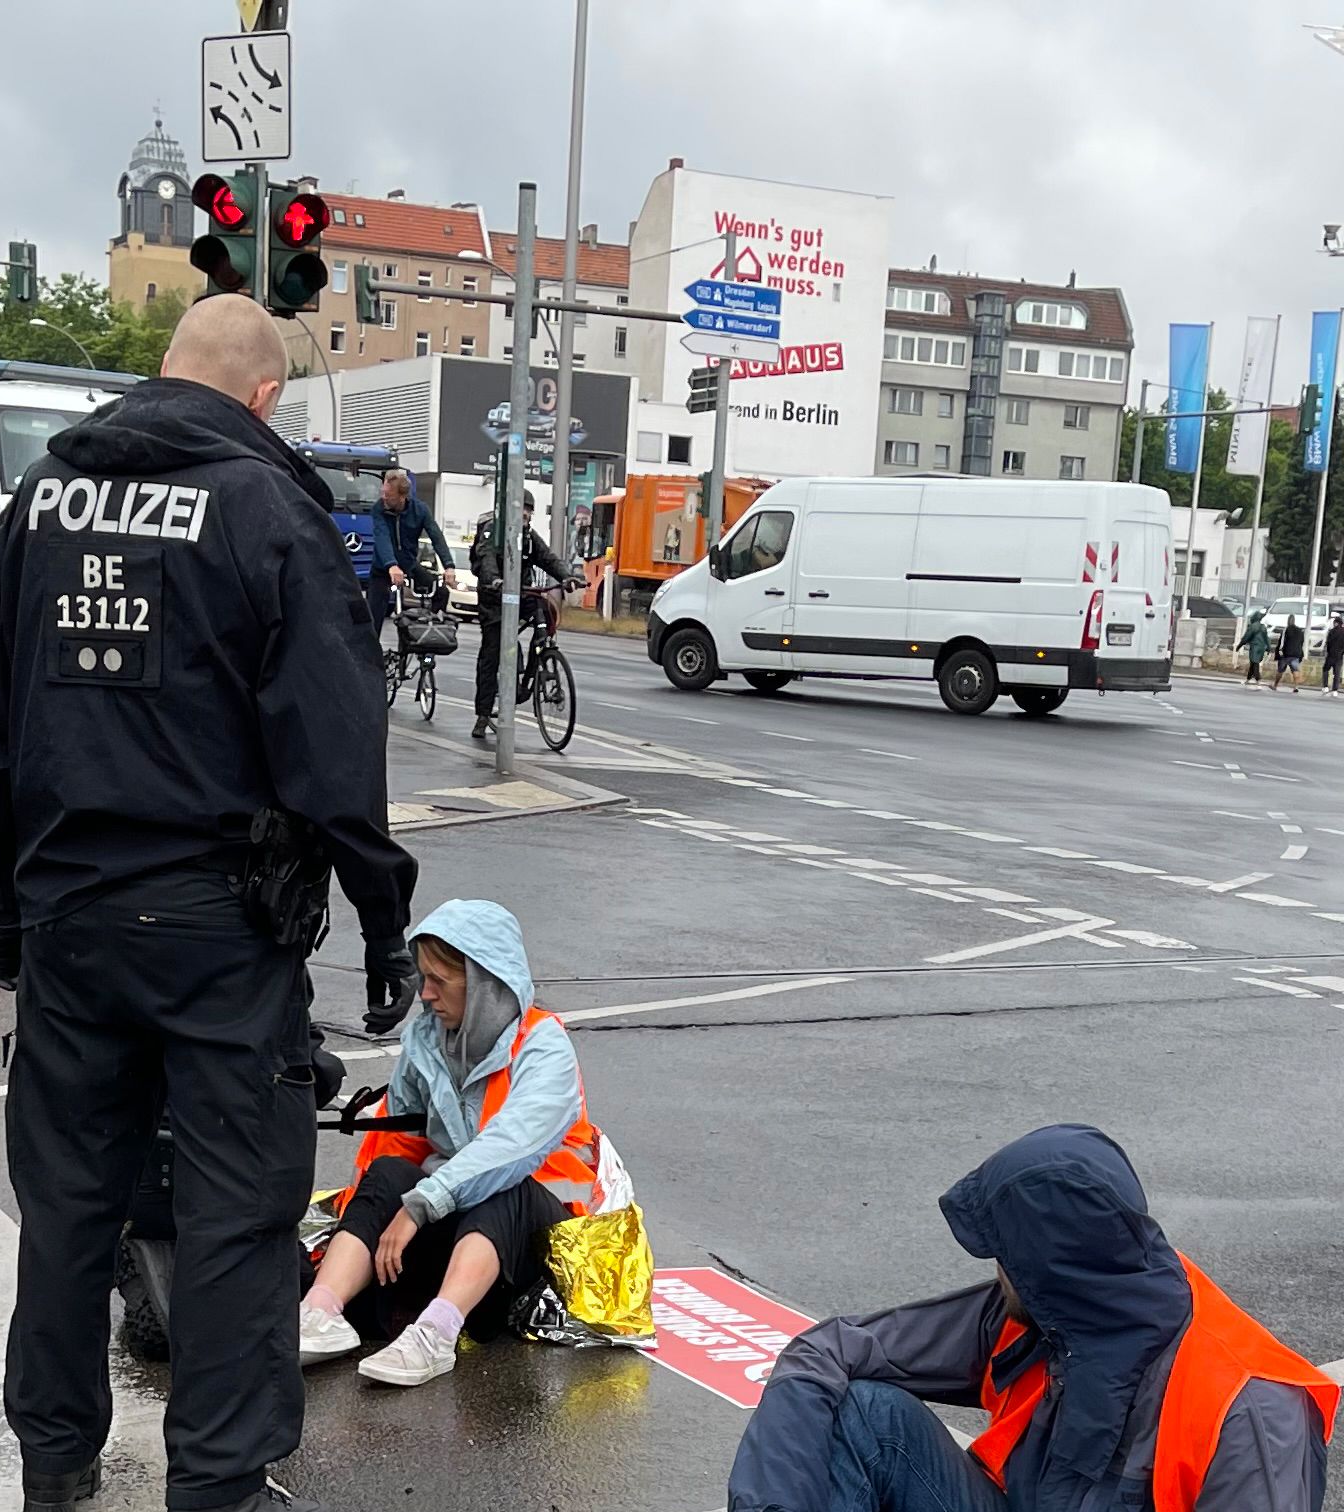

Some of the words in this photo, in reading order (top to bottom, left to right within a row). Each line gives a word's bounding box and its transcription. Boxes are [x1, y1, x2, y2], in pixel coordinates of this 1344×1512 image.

[715, 211, 784, 242] Wenn's
[791, 228, 824, 252] gut
[767, 251, 845, 278] werden
[767, 275, 822, 297] muss.
[764, 404, 778, 420] in
[782, 400, 839, 426] Berlin
[28, 477, 210, 543] POLIZEI
[83, 554, 125, 590] BE
[57, 594, 150, 632] 13112
